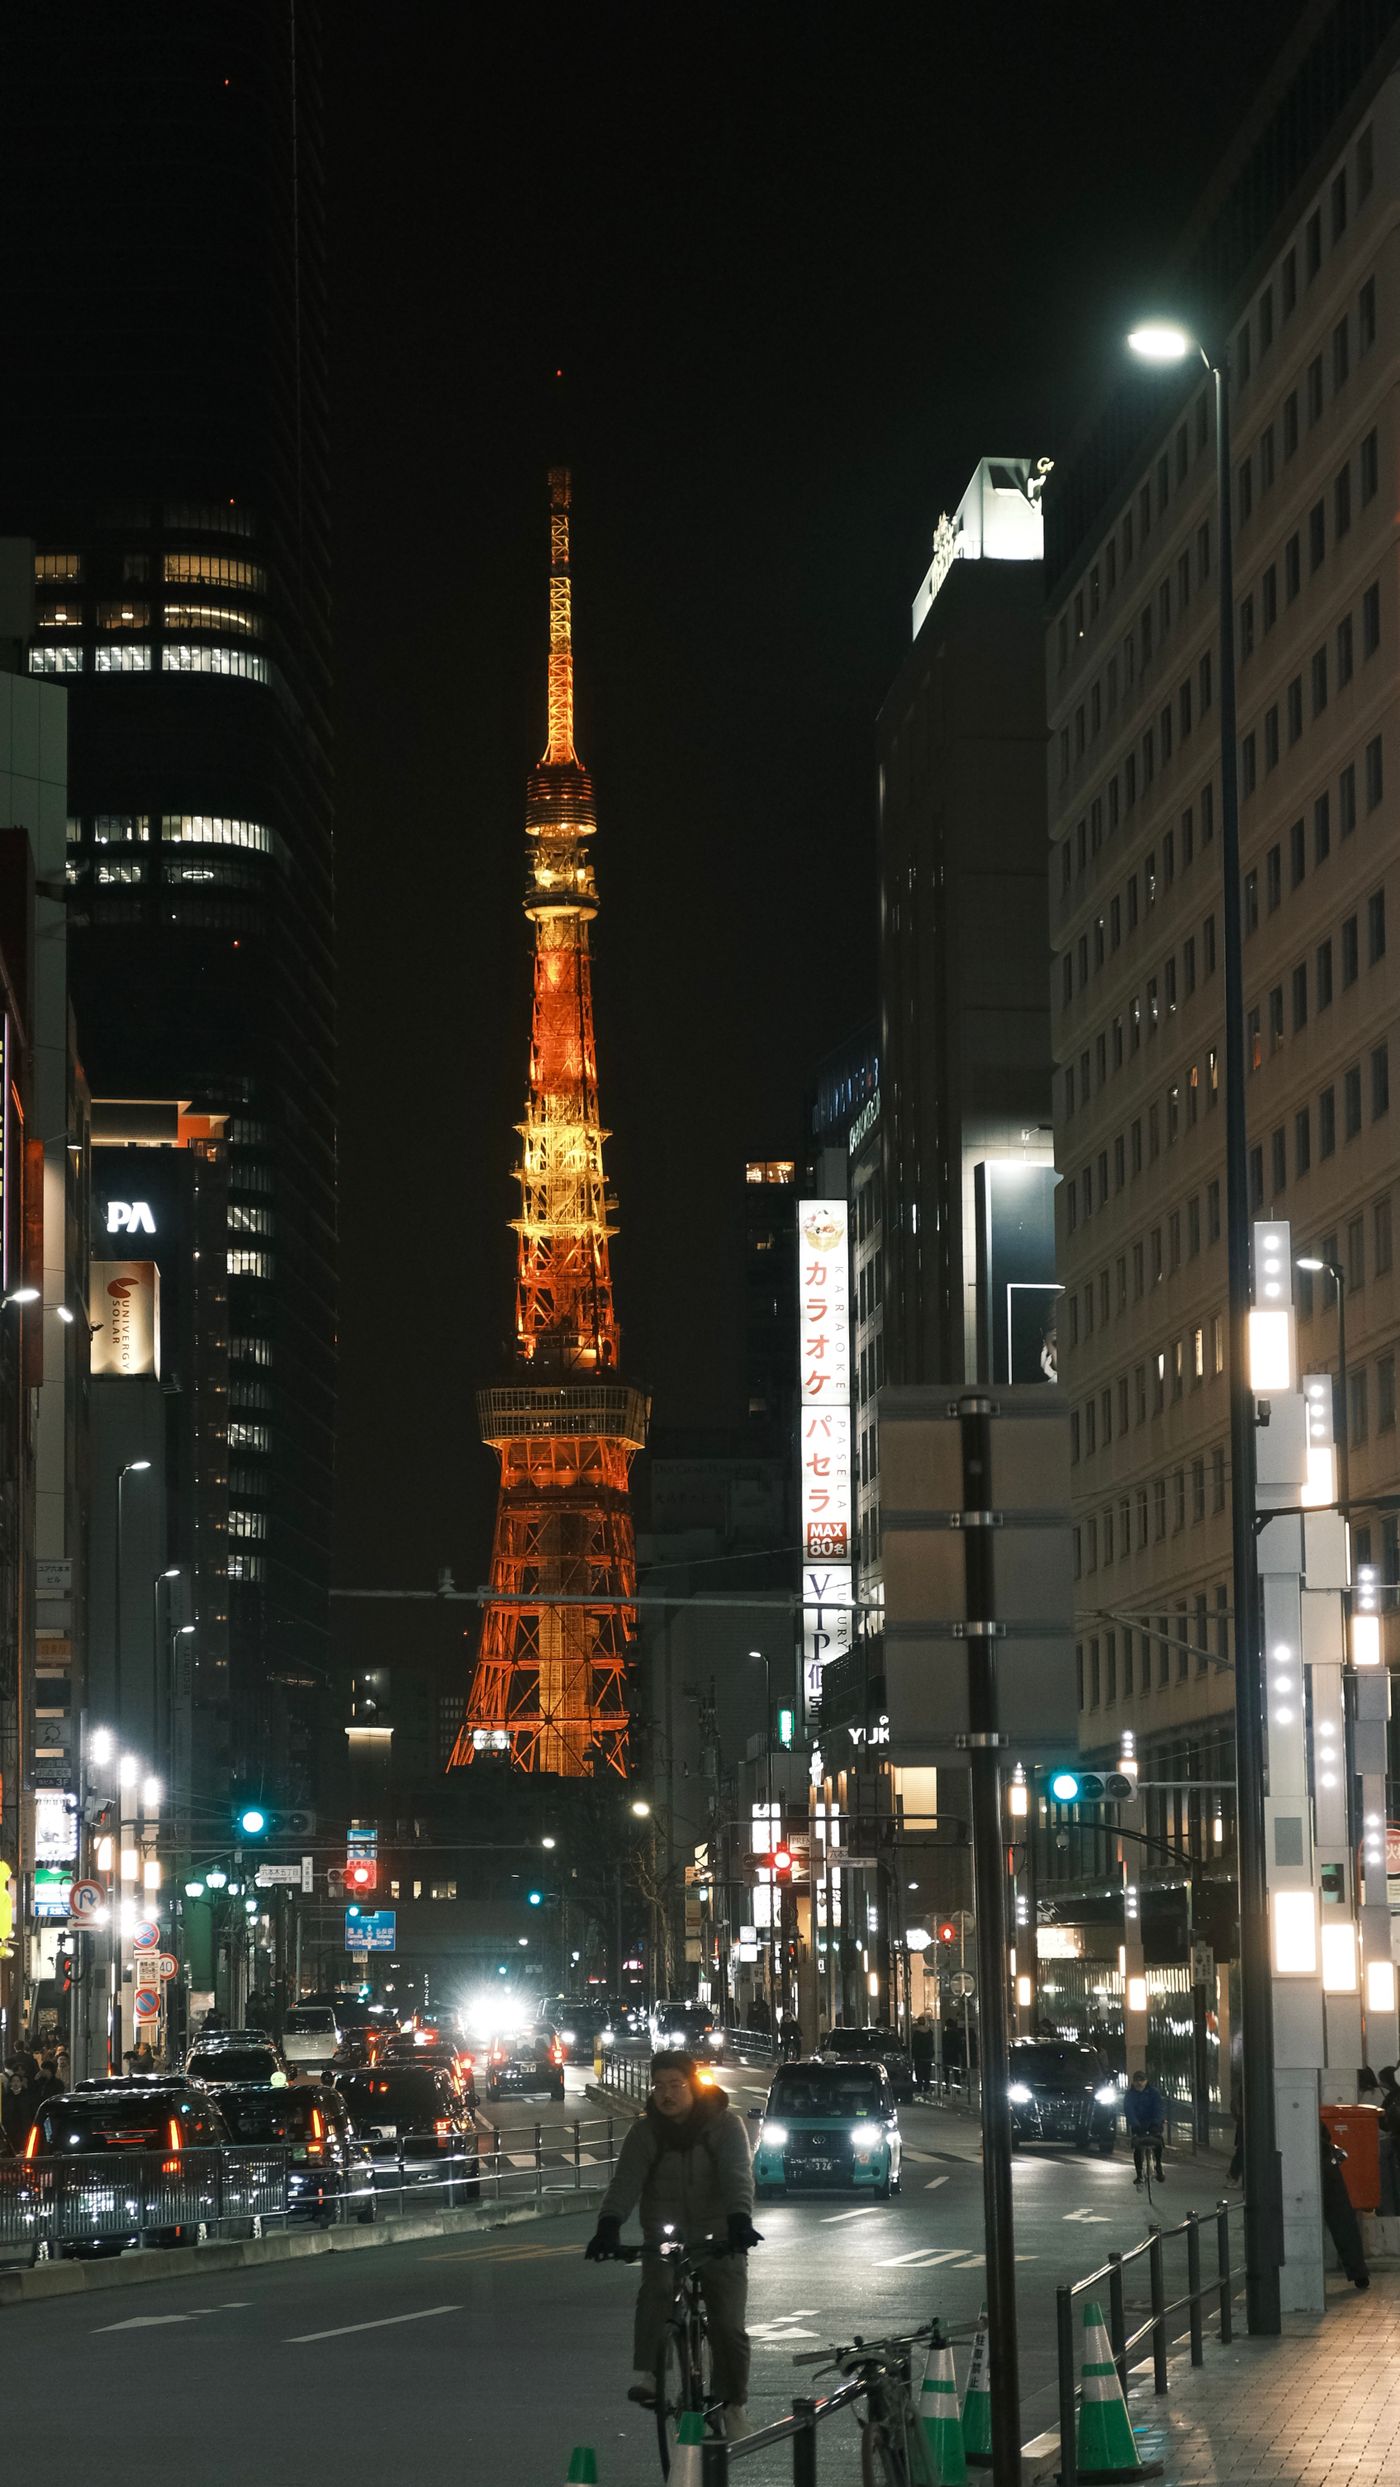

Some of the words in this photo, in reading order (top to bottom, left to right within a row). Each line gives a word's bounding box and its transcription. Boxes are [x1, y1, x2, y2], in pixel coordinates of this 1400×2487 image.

[107, 1201, 156, 1233] PA
[112, 1300, 120, 1344] SOLAR
[122, 1300, 130, 1369] UNIVERGY
[805, 1261, 831, 1395] カラオケ
[835, 1266, 845, 1389] KARAOKE
[806, 1415, 832, 1513] パセラ
[837, 1420, 846, 1509] PASELA
[810, 1524, 843, 1537] MAX
[810, 1537, 845, 1555] 80名
[837, 1582, 848, 1650] UURY
[261, 1868, 299, 1876] 六本木五丁目
[160, 1961, 173, 1972] 40
[969, 2333, 986, 2388] 駐車禁止
